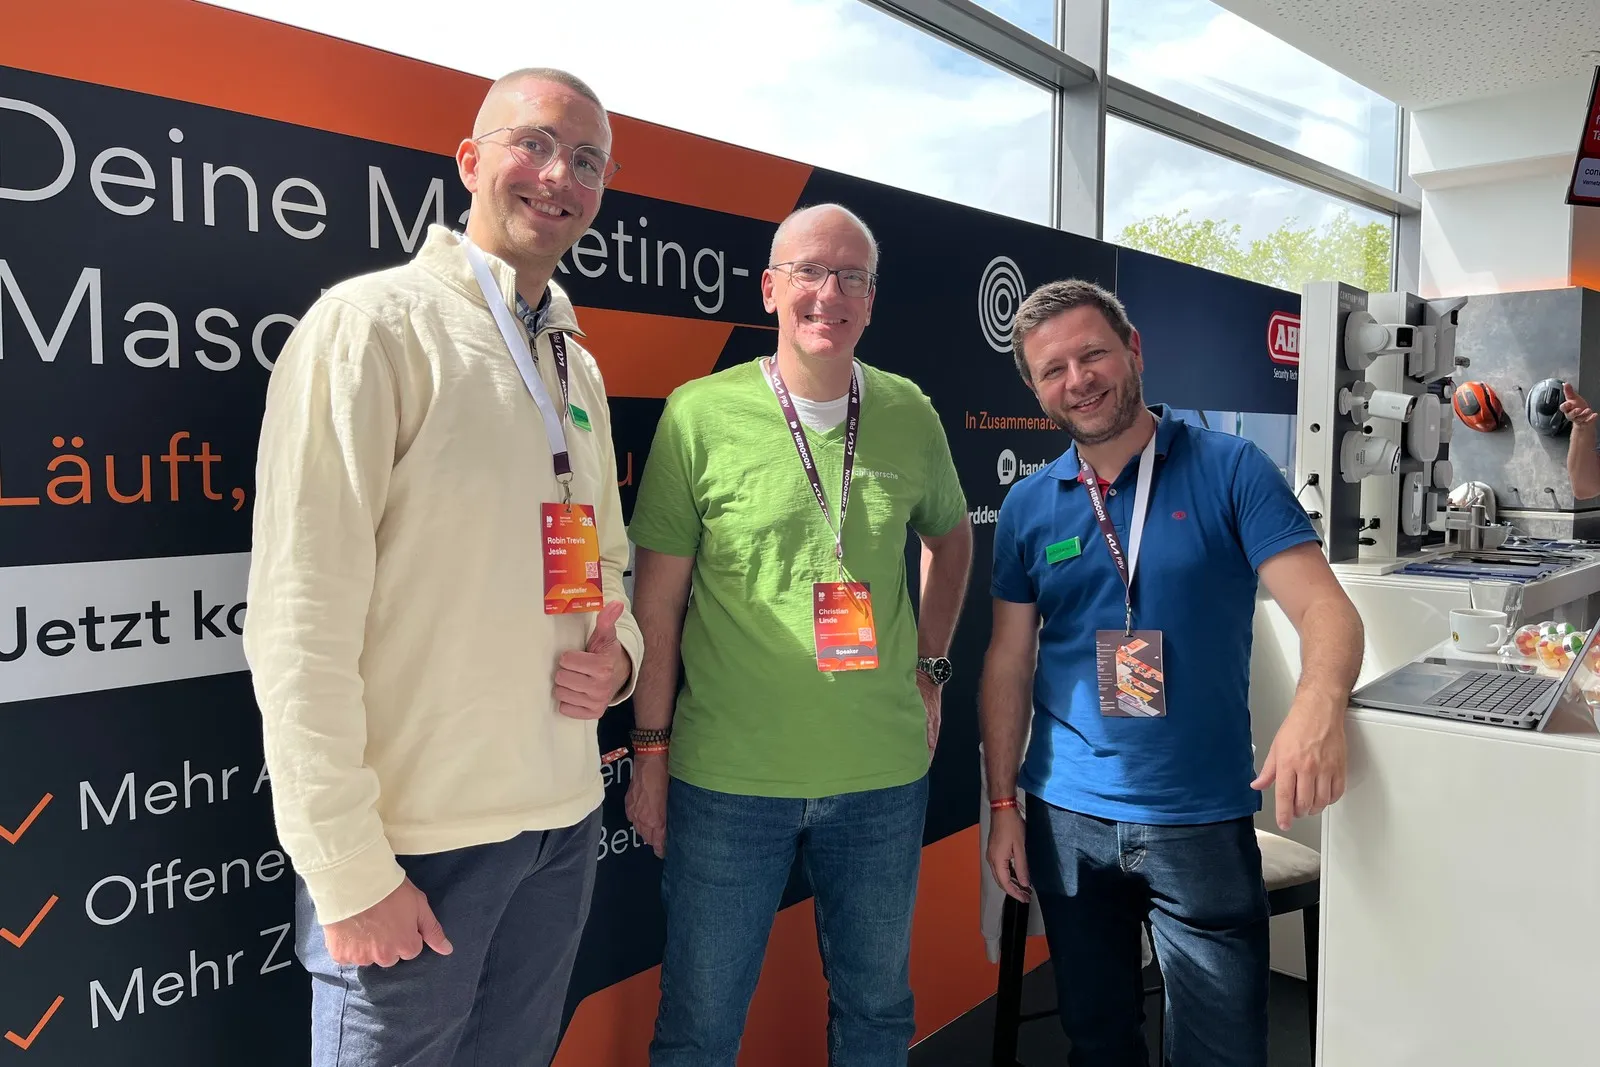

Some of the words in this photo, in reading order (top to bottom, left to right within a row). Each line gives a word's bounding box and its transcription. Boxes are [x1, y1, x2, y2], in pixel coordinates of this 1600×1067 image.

[0, 97, 327, 240] Deine
[0, 259, 302, 371] Masc
[1274, 324, 1299, 353] AB
[965, 411, 976, 429] In
[794, 431, 812, 469] HEROCON
[1019, 458, 1049, 476] hand
[1089, 487, 1106, 521] HEROCON
[547, 536, 566, 544] Robin
[566, 536, 586, 545] Trevis
[548, 547, 567, 555] Jeske
[561, 587, 587, 595] Aussteller
[0, 600, 170, 662] Jetzt
[835, 648, 859, 656] Speaker
[79, 760, 240, 831] Mehr
[85, 850, 285, 926] Offene
[89, 950, 244, 1029] Mehr
[259, 922, 292, 975] Z
